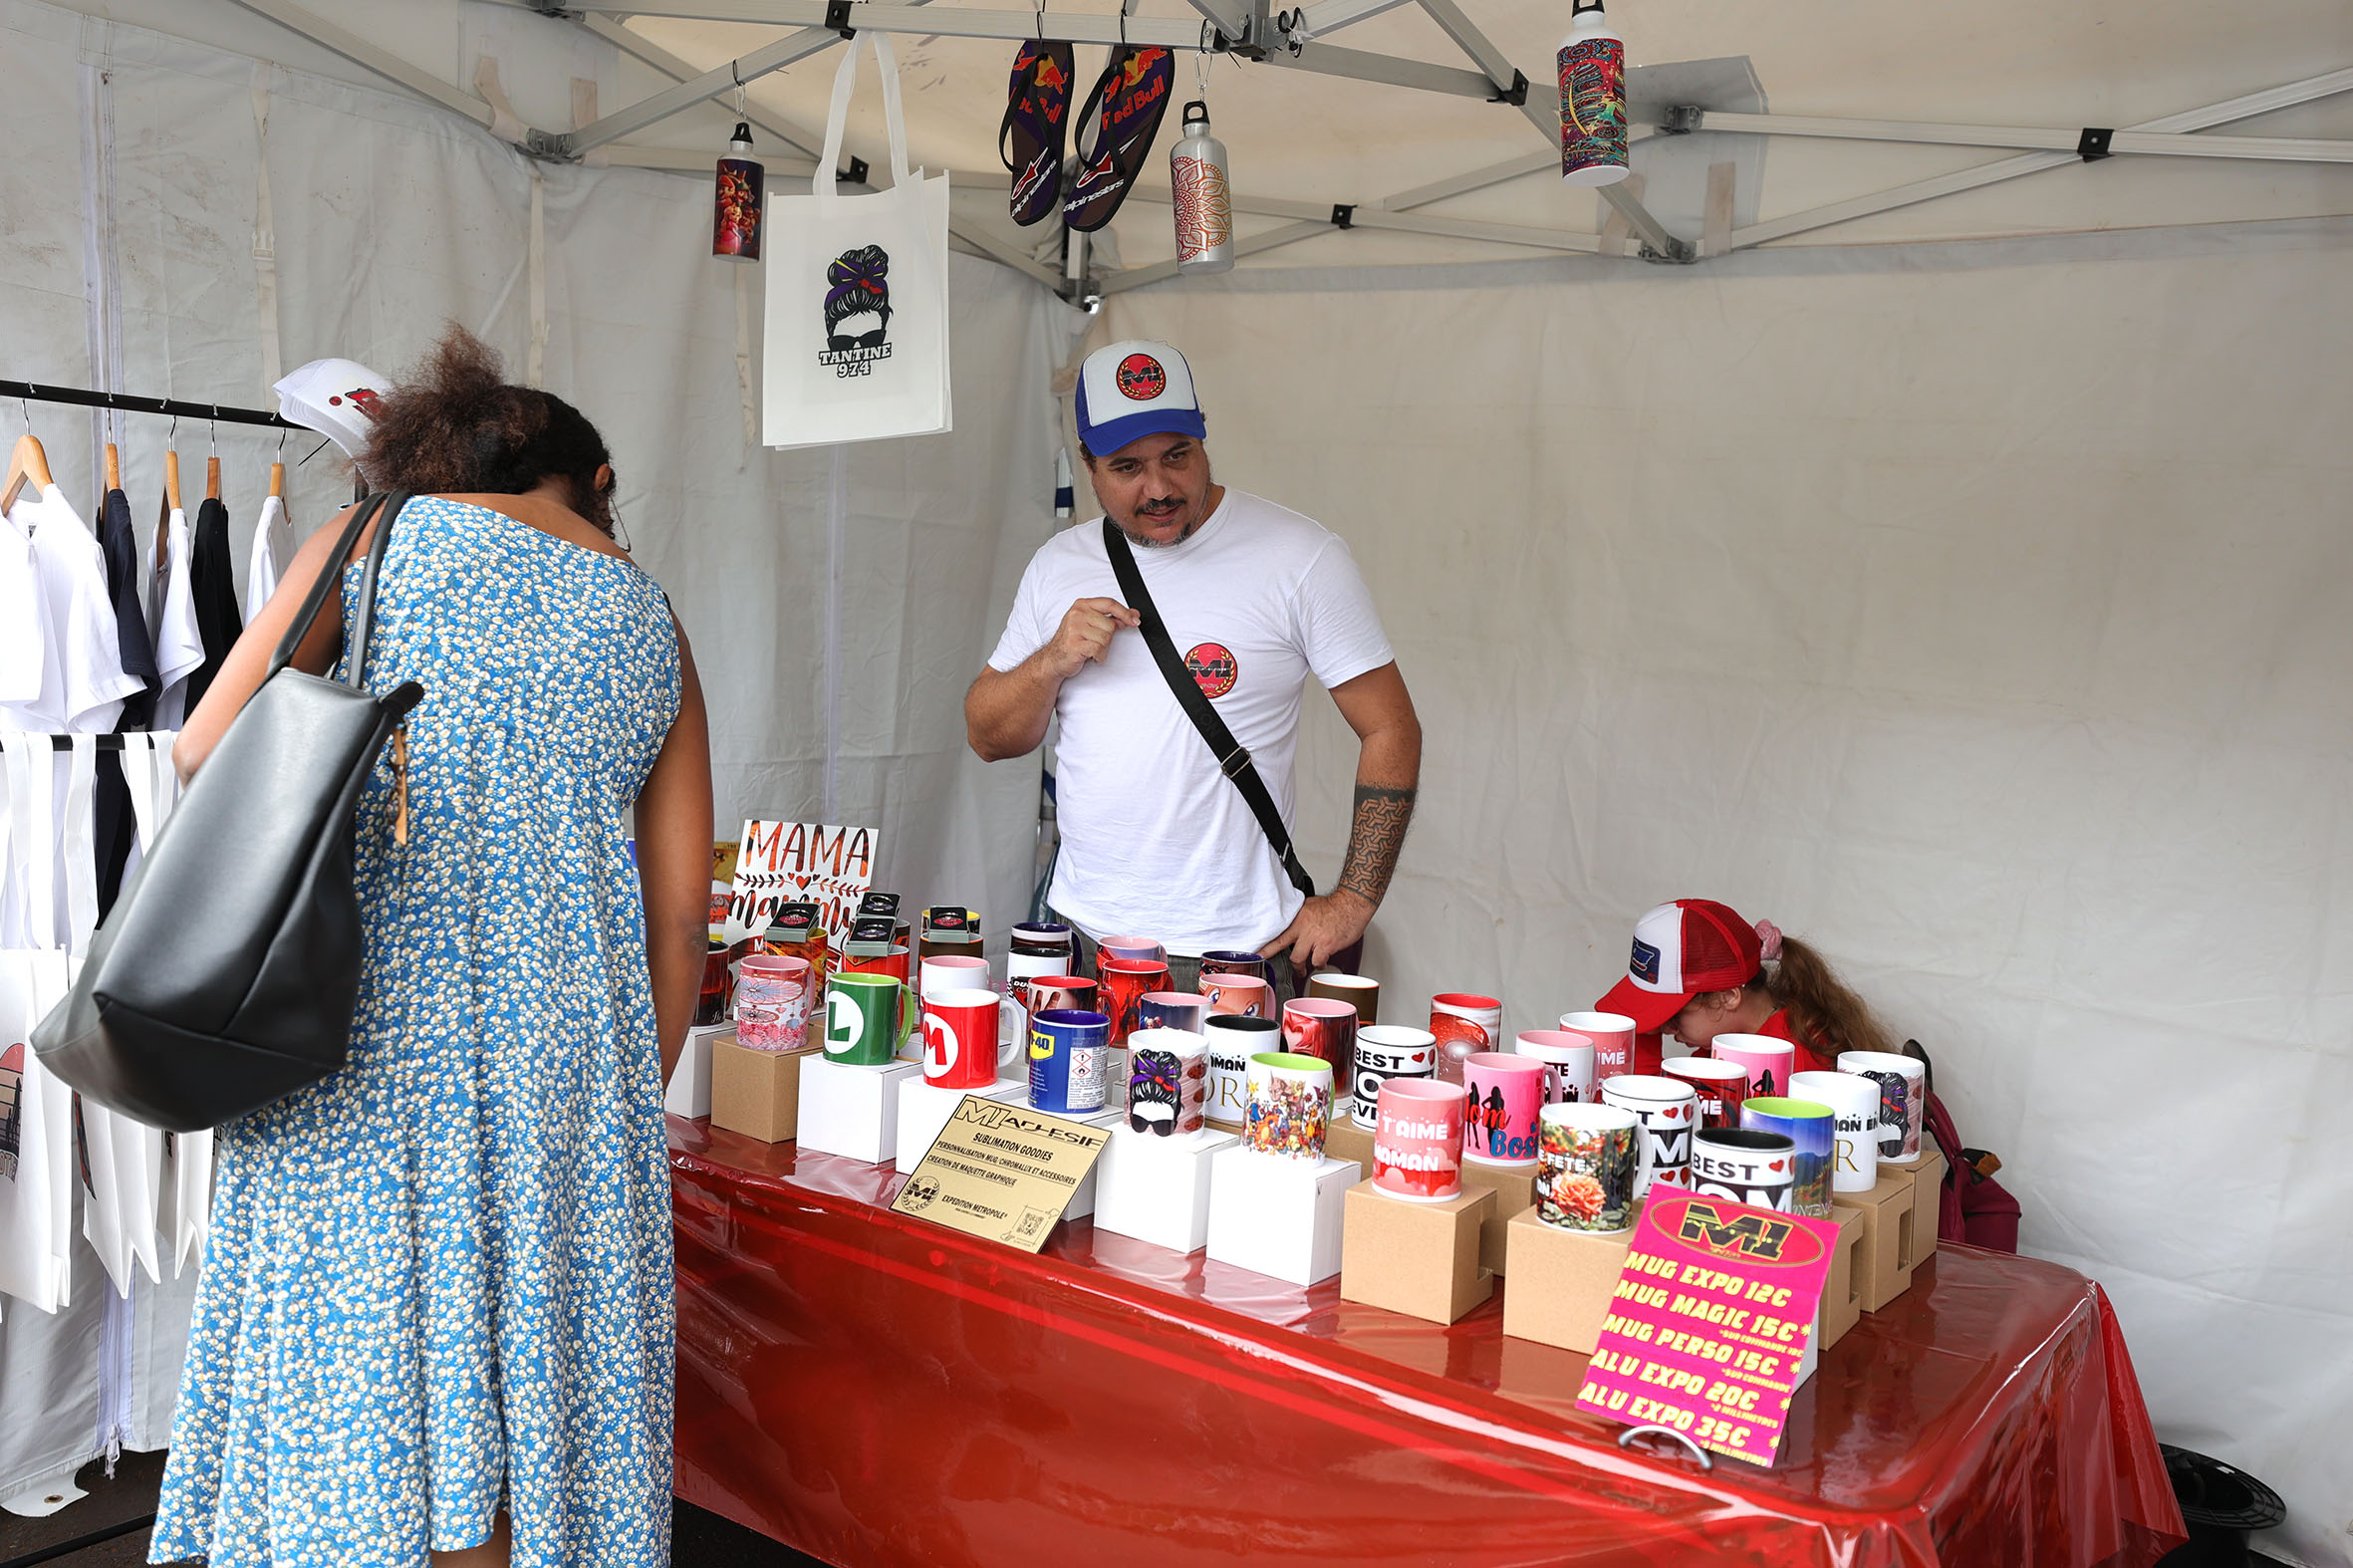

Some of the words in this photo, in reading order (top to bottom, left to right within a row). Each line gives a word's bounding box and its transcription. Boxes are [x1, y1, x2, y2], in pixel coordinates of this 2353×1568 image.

[1135, 75, 1165, 110] Bull
[1062, 178, 1125, 212] alpinestars
[818, 342, 893, 366] TANTINE
[837, 361, 872, 379] 974
[745, 819, 870, 878] MAMA
[973, 1132, 1020, 1153] SUBLIMATION
[1020, 1145, 1054, 1162] GOODIES
[1039, 1169, 1077, 1185] ACCESSOIRES
[1623, 1250, 1679, 1280] MUG
[1679, 1264, 1745, 1295] EXPO
[1613, 1279, 1670, 1309] MUG
[1669, 1293, 1751, 1330] MAGIC
[1601, 1313, 1655, 1342] MUG
[1655, 1327, 1734, 1364] PERSO
[1588, 1348, 1641, 1377] ALU
[1639, 1361, 1706, 1396] EXPO
[1577, 1381, 1630, 1411] ALU
[1627, 1396, 1696, 1432] EXPO
